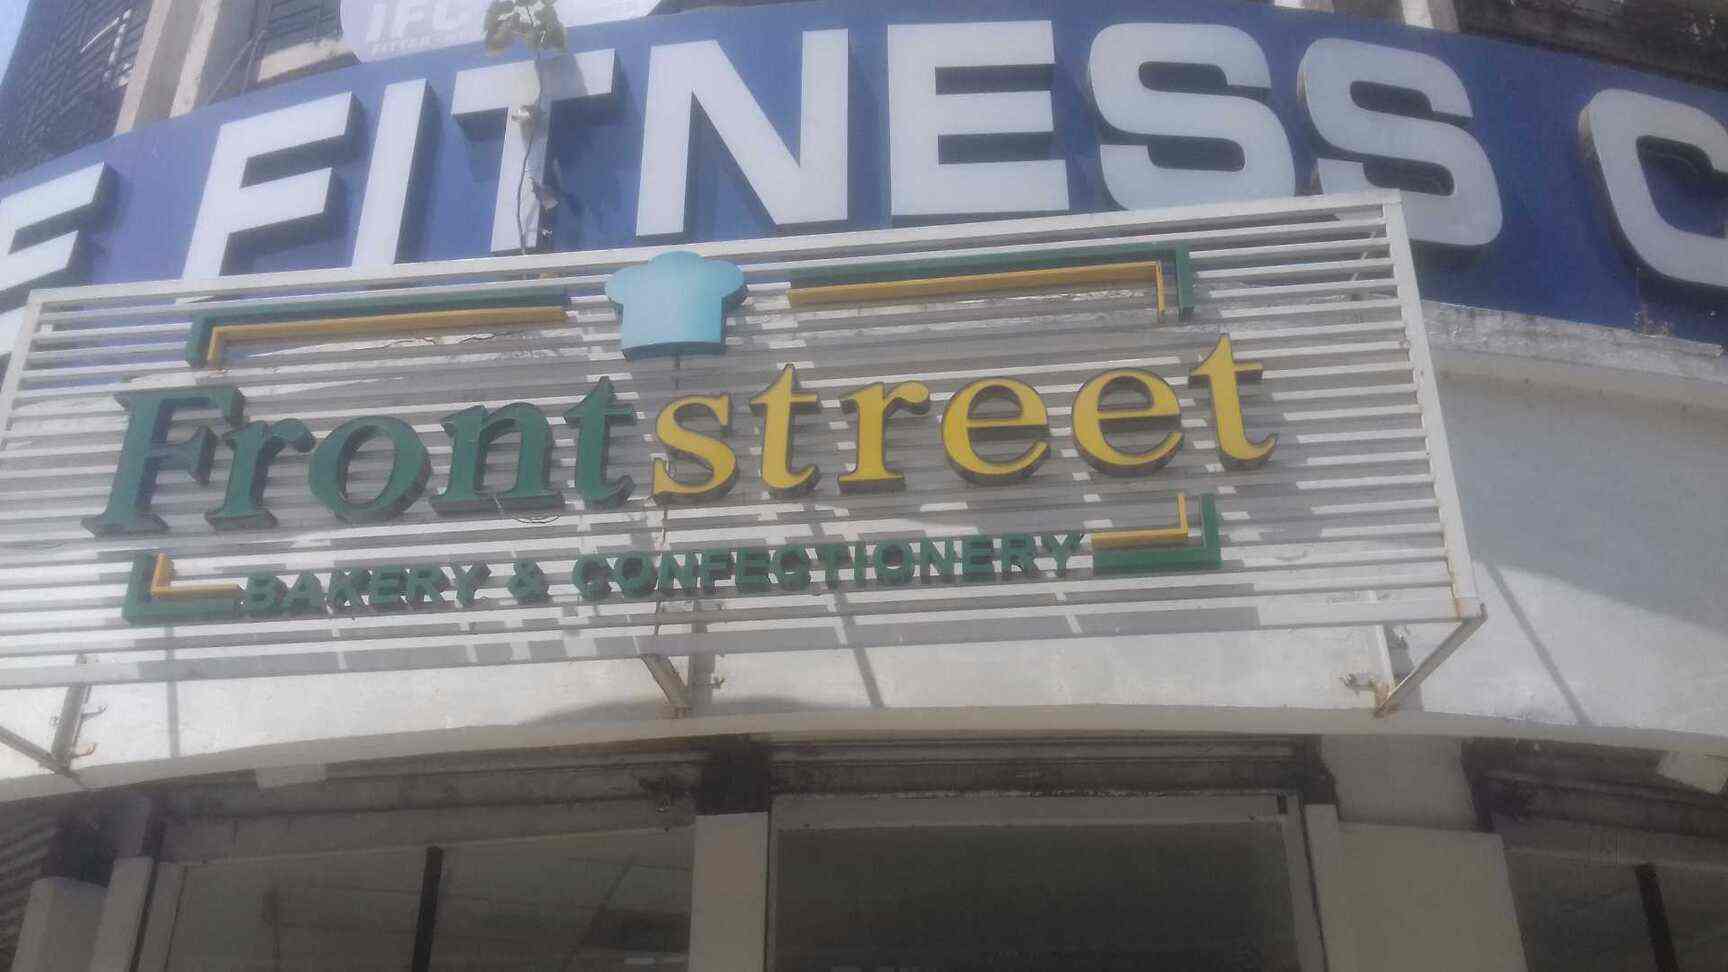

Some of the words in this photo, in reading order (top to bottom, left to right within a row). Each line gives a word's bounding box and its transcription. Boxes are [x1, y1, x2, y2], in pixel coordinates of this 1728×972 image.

[180, 20, 1504, 282] FITNESS
[83, 335, 1278, 540] Frontstreet
[247, 560, 489, 613] BAKERY
[508, 558, 550, 605] &
[571, 531, 1085, 602] CONFECTIONERY
